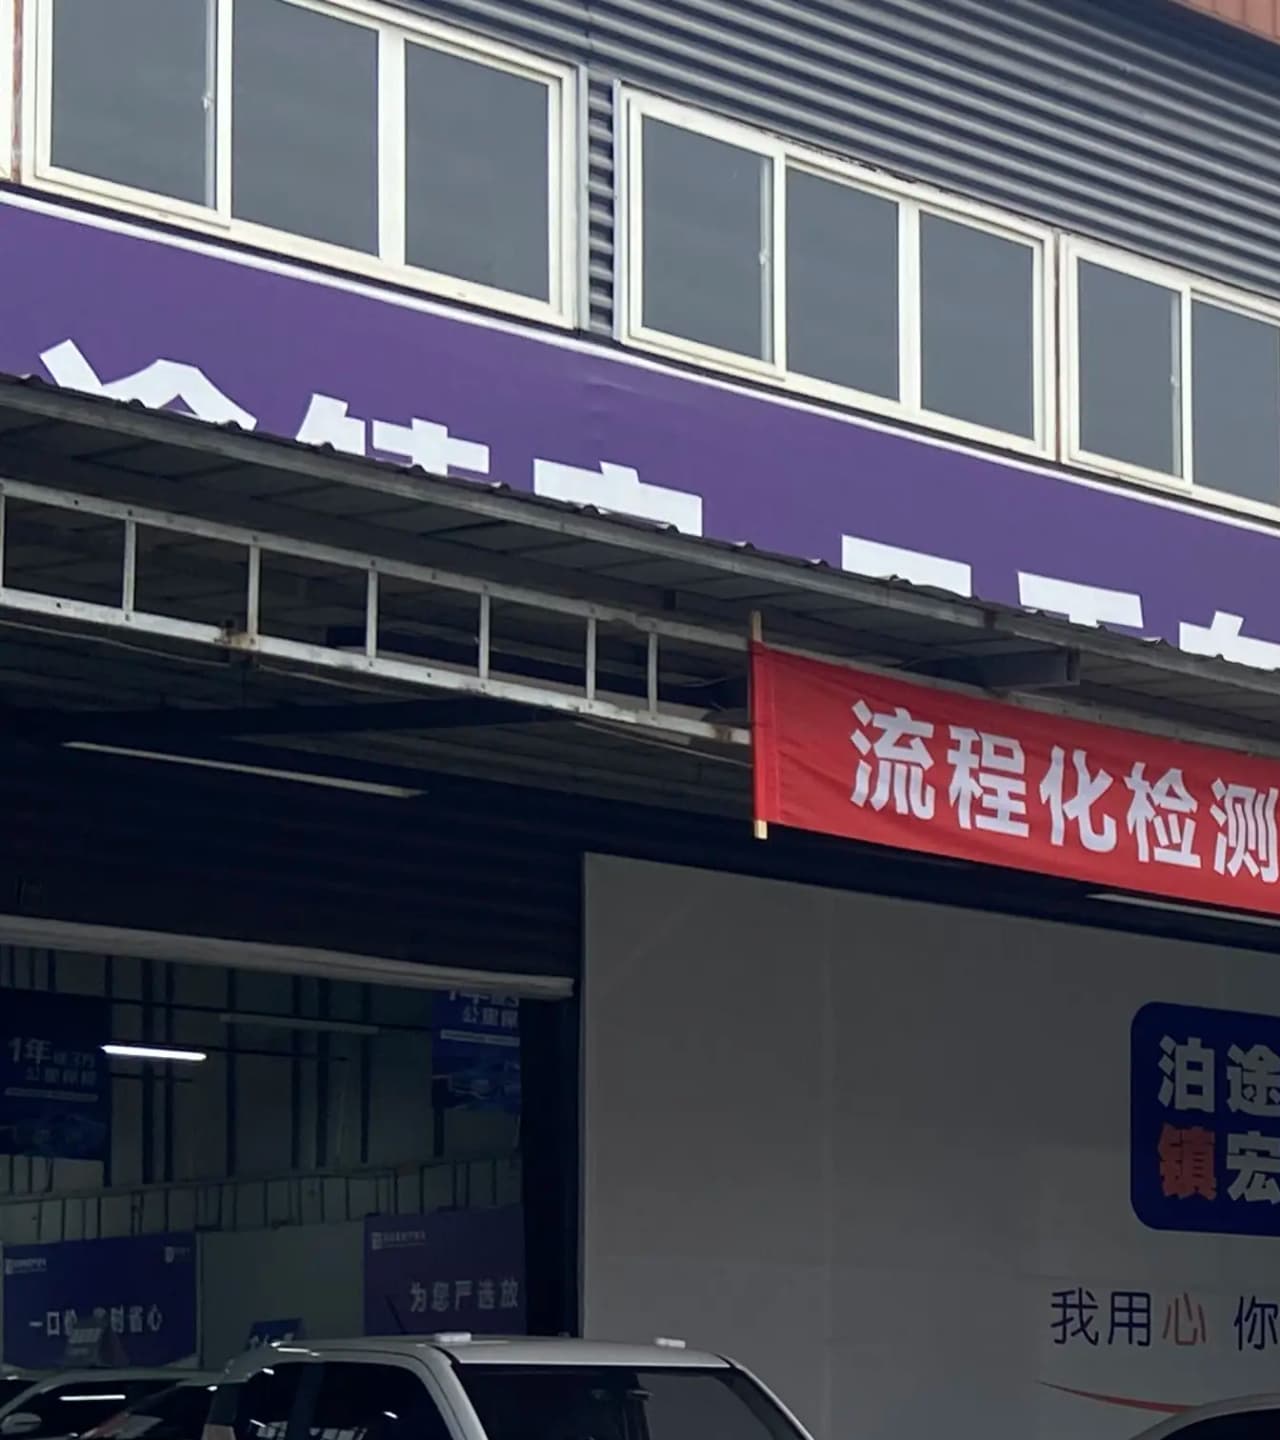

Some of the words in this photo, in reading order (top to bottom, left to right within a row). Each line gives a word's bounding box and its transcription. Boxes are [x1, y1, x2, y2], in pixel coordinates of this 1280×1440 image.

[850, 700, 1280, 883] 流程化检测
[1051, 1287, 1207, 1347] 我用心
